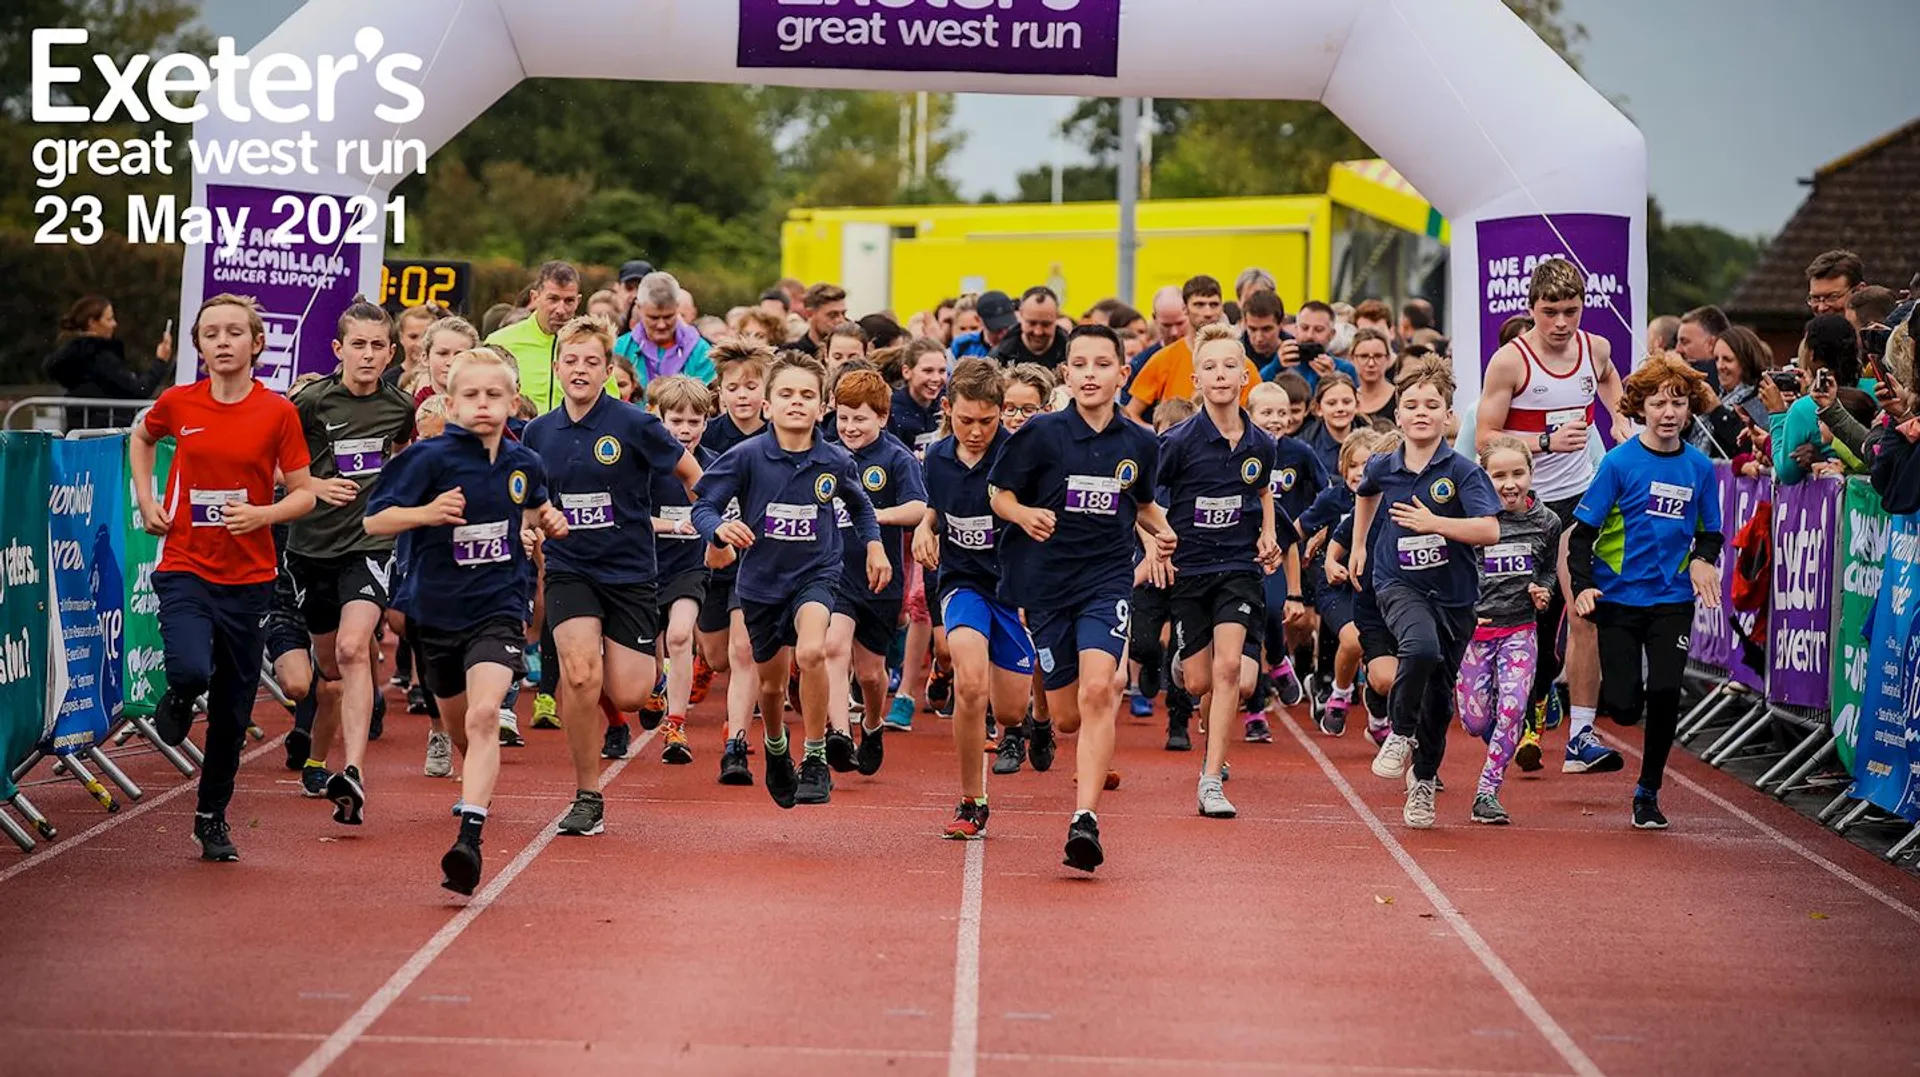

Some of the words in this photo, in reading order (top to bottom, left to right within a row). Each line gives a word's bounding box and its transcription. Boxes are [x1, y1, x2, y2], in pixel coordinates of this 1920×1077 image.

[777, 12, 886, 52] great
[898, 14, 1000, 47] west
[1011, 20, 1083, 49] run
[213, 247, 351, 277] MACMILLAN.
[1488, 256, 1520, 278] WE
[213, 267, 267, 284] CANCER
[269, 273, 337, 290] SUPPORT
[353, 453, 364, 471] 3
[1076, 491, 1113, 510] 189
[1655, 497, 1685, 516] 112
[569, 507, 606, 525] 154
[1203, 509, 1235, 524] 187
[773, 518, 812, 536] 213
[956, 530, 987, 546] 169
[464, 538, 502, 559] 178
[1407, 548, 1442, 567] 196
[1493, 555, 1527, 573] 113
